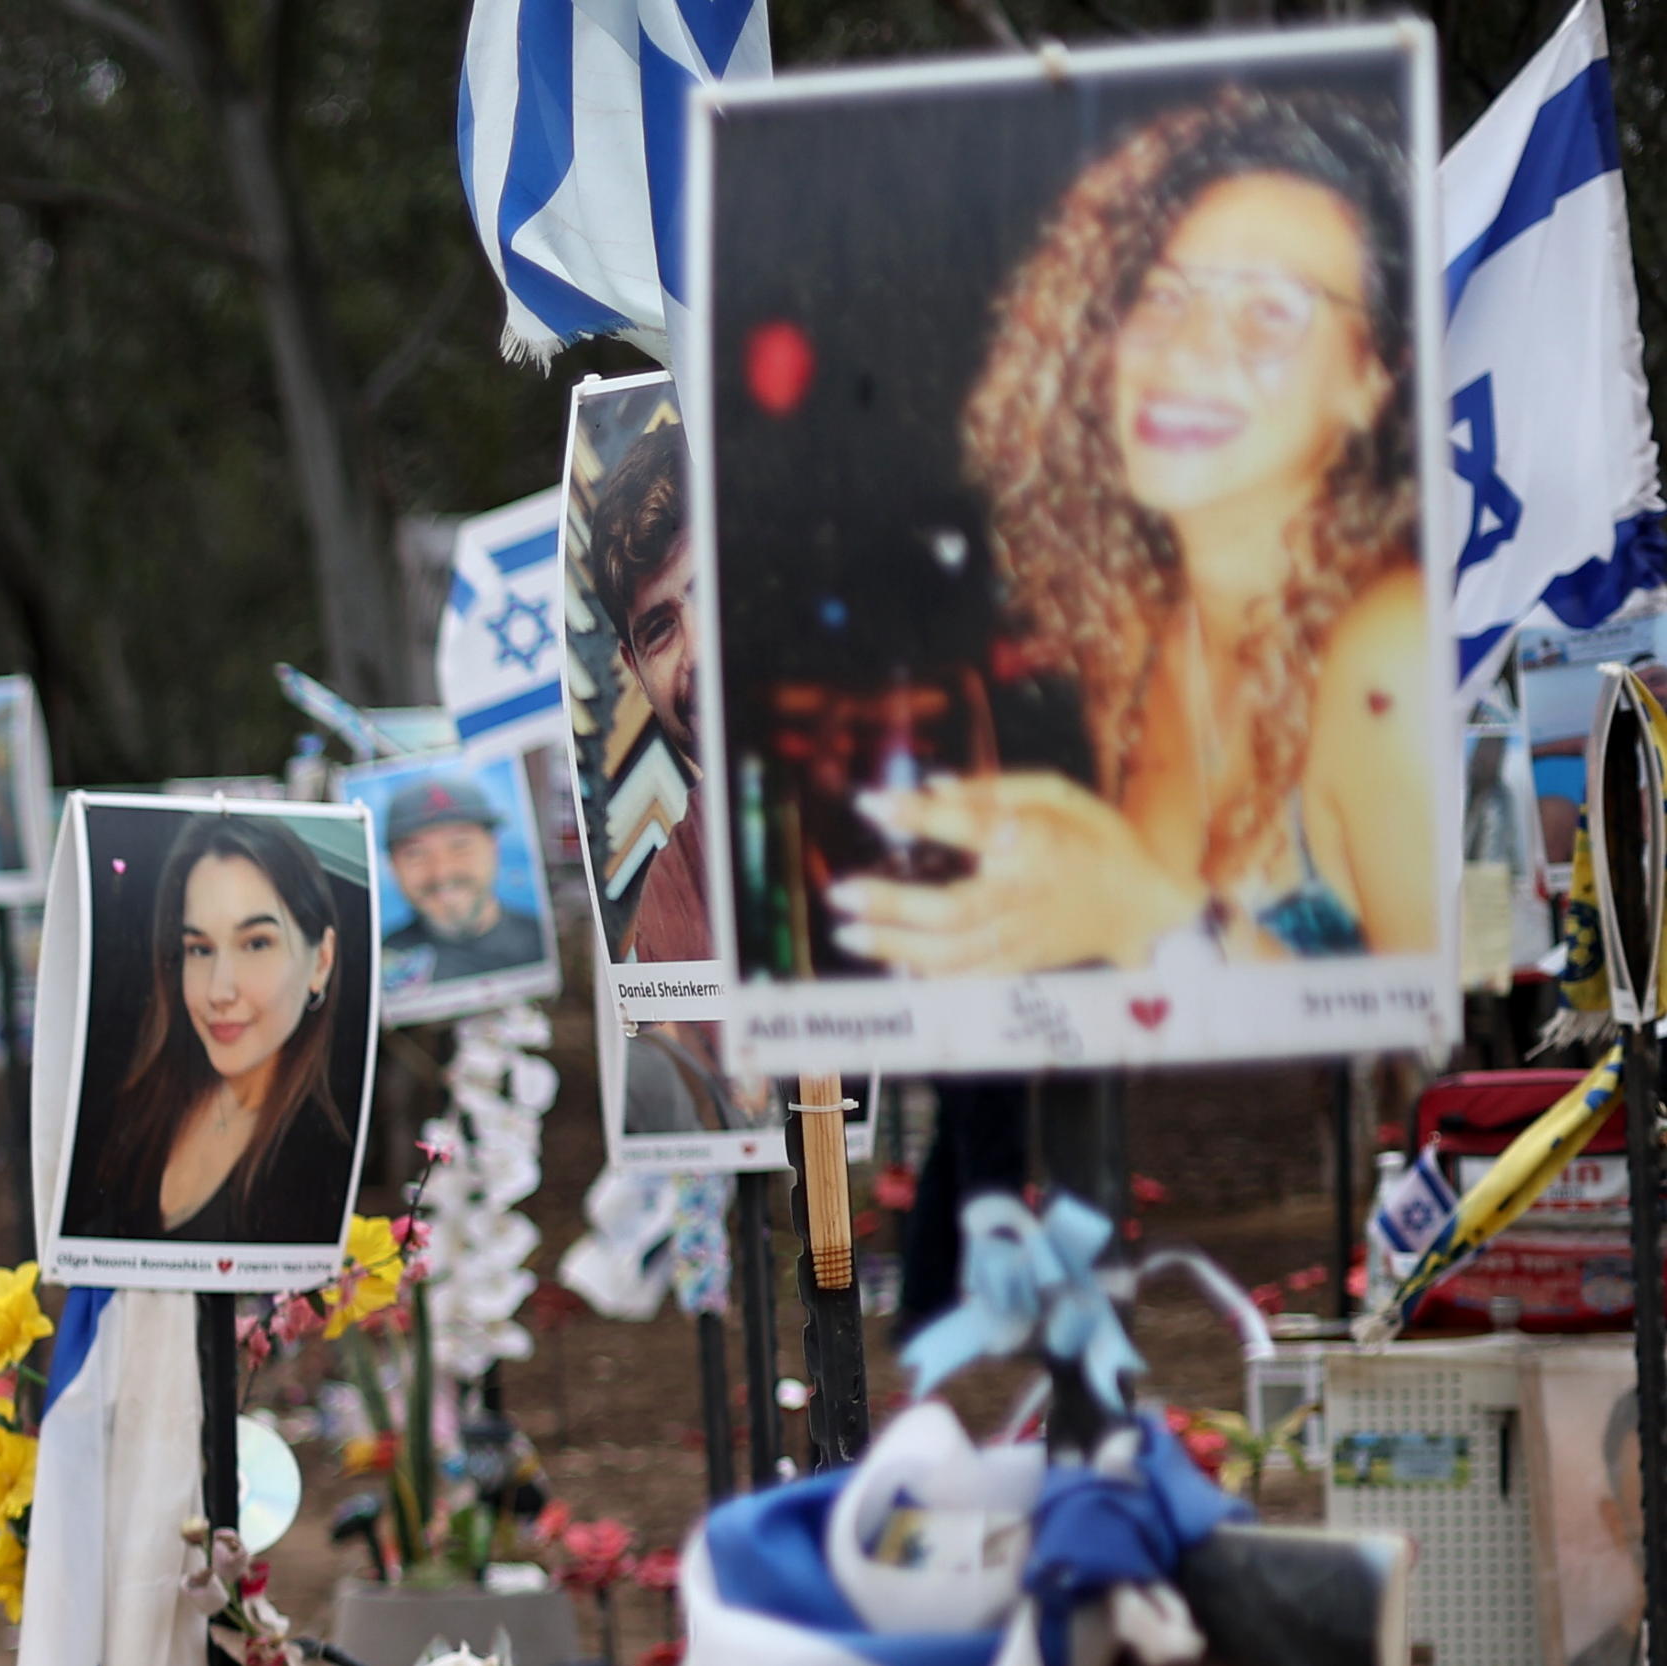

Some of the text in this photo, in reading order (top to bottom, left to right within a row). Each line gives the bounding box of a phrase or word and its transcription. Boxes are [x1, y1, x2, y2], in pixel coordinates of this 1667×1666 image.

[618, 981, 657, 998] Daniel
[57, 1253, 213, 1272] Olga Naomi Romashkin
